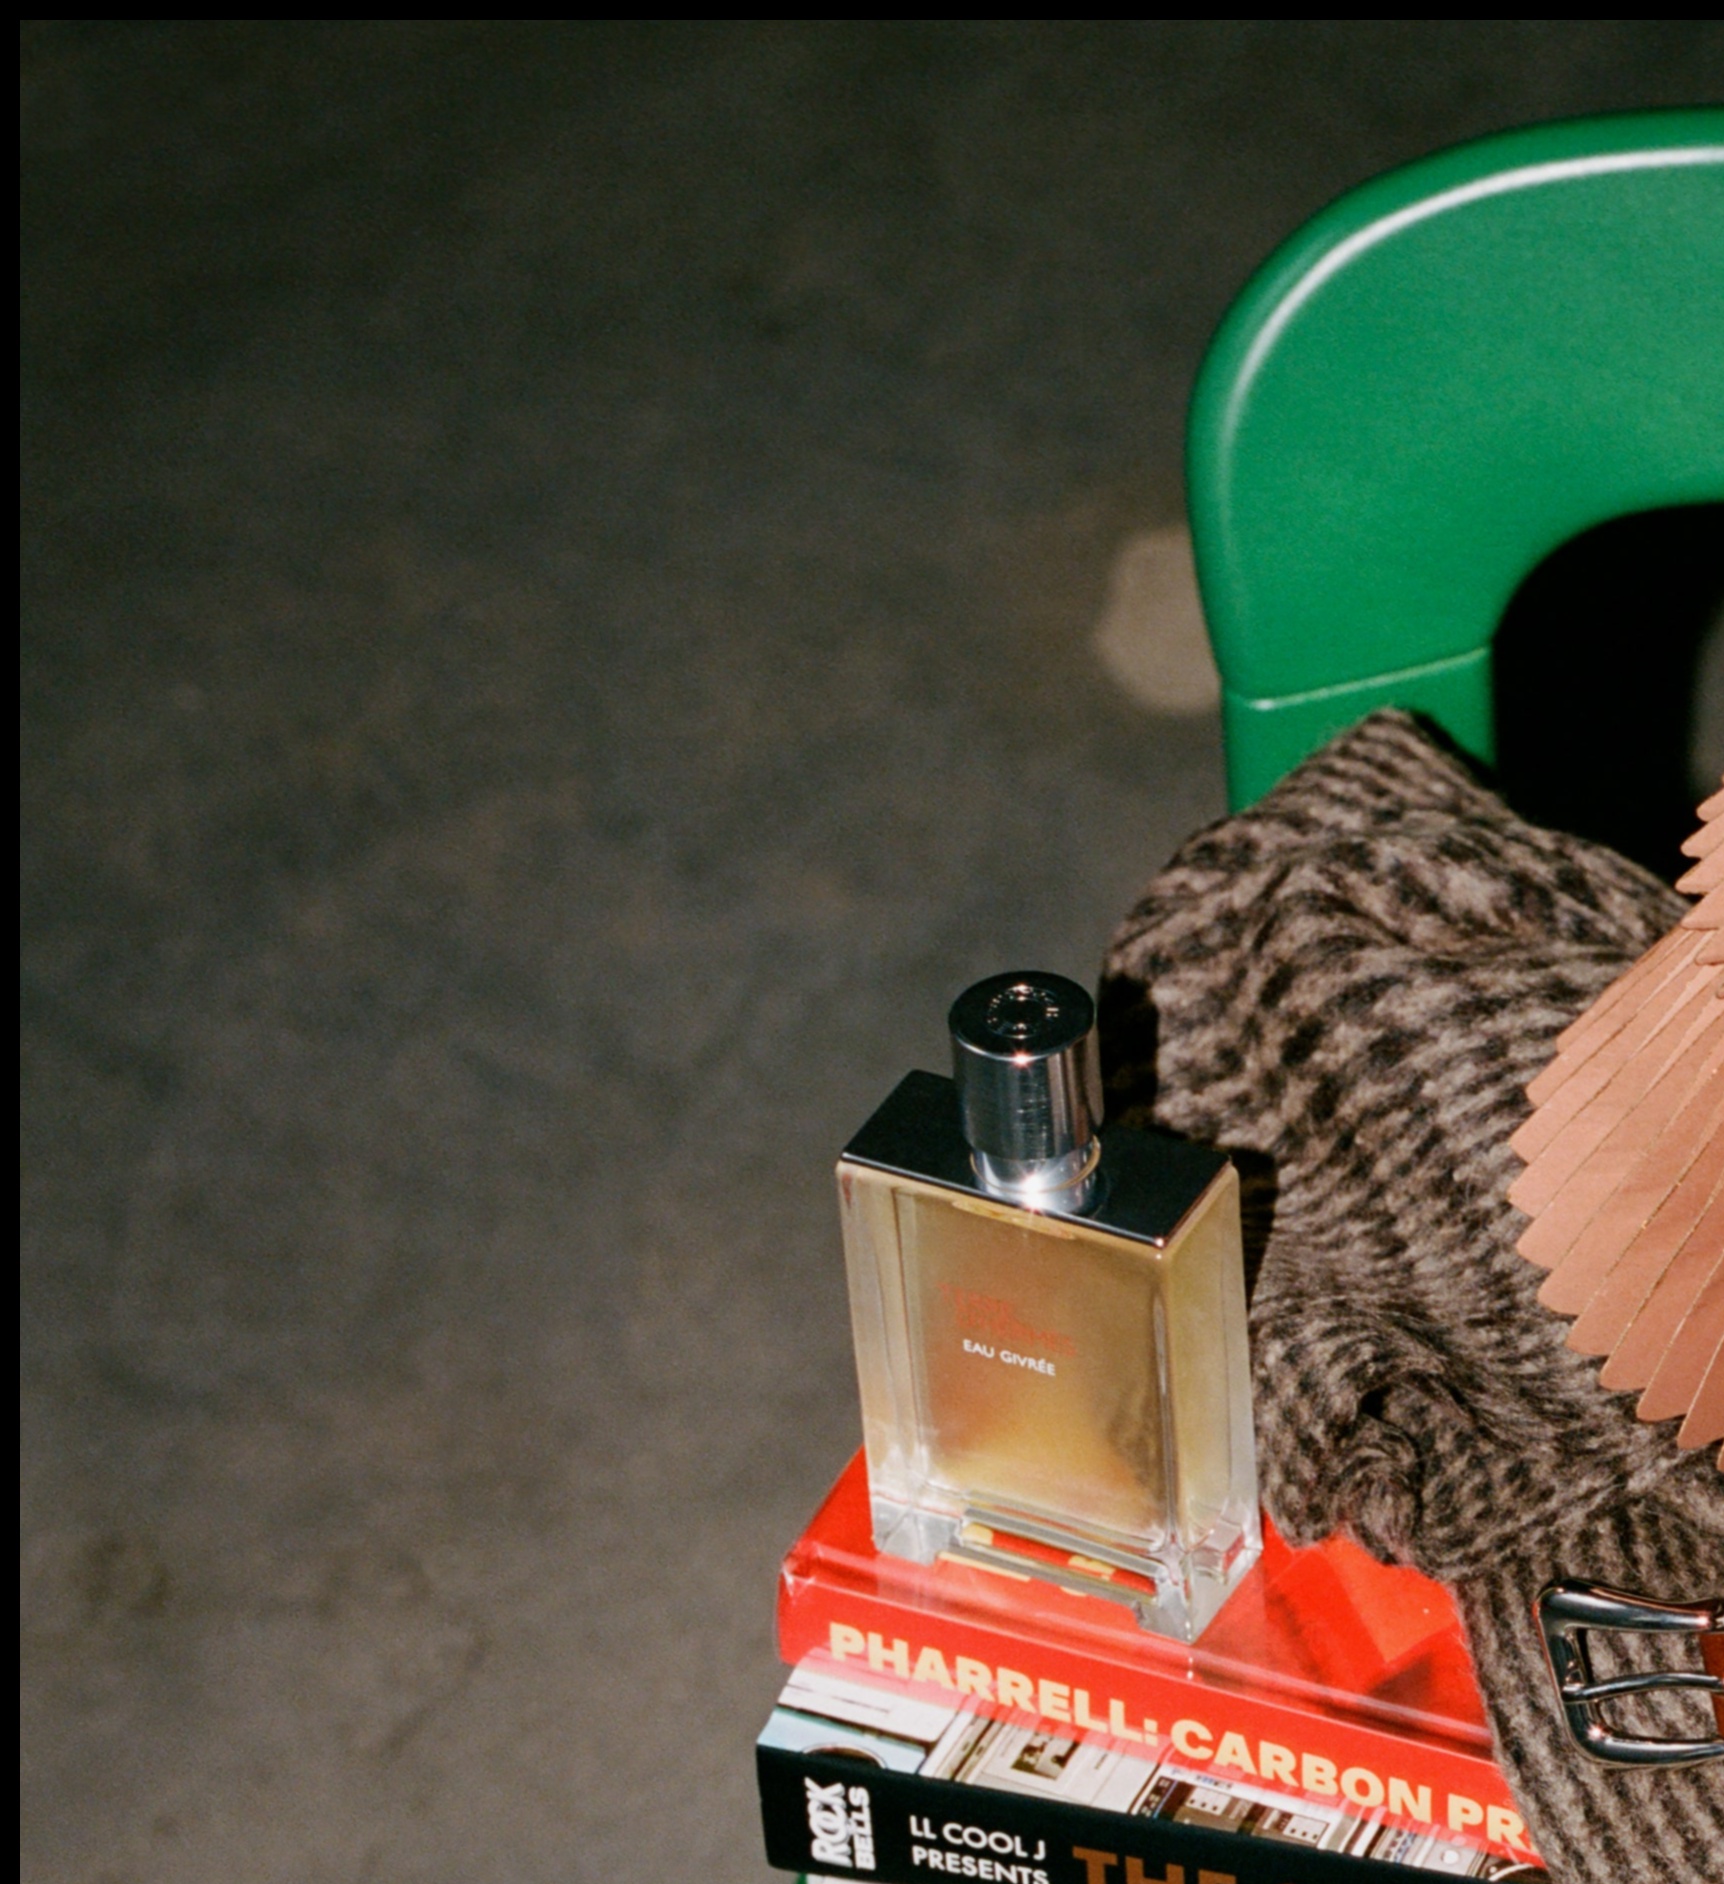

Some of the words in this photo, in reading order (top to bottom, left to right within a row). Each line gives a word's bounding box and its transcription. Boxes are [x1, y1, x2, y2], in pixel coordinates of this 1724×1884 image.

[963, 1338, 995, 1359] EAU
[1000, 1349, 1056, 1377] GIVRÉE
[829, 1622, 1158, 1744] PHARRELL:
[1171, 1720, 1433, 1824] CARBON
[1447, 1792, 1539, 1851] PR
[804, 1776, 853, 1869] ROCK
[848, 1786, 876, 1870] BELLS
[909, 1814, 938, 1841] LL
[942, 1822, 1029, 1858] COOL
[1033, 1839, 1046, 1861] J
